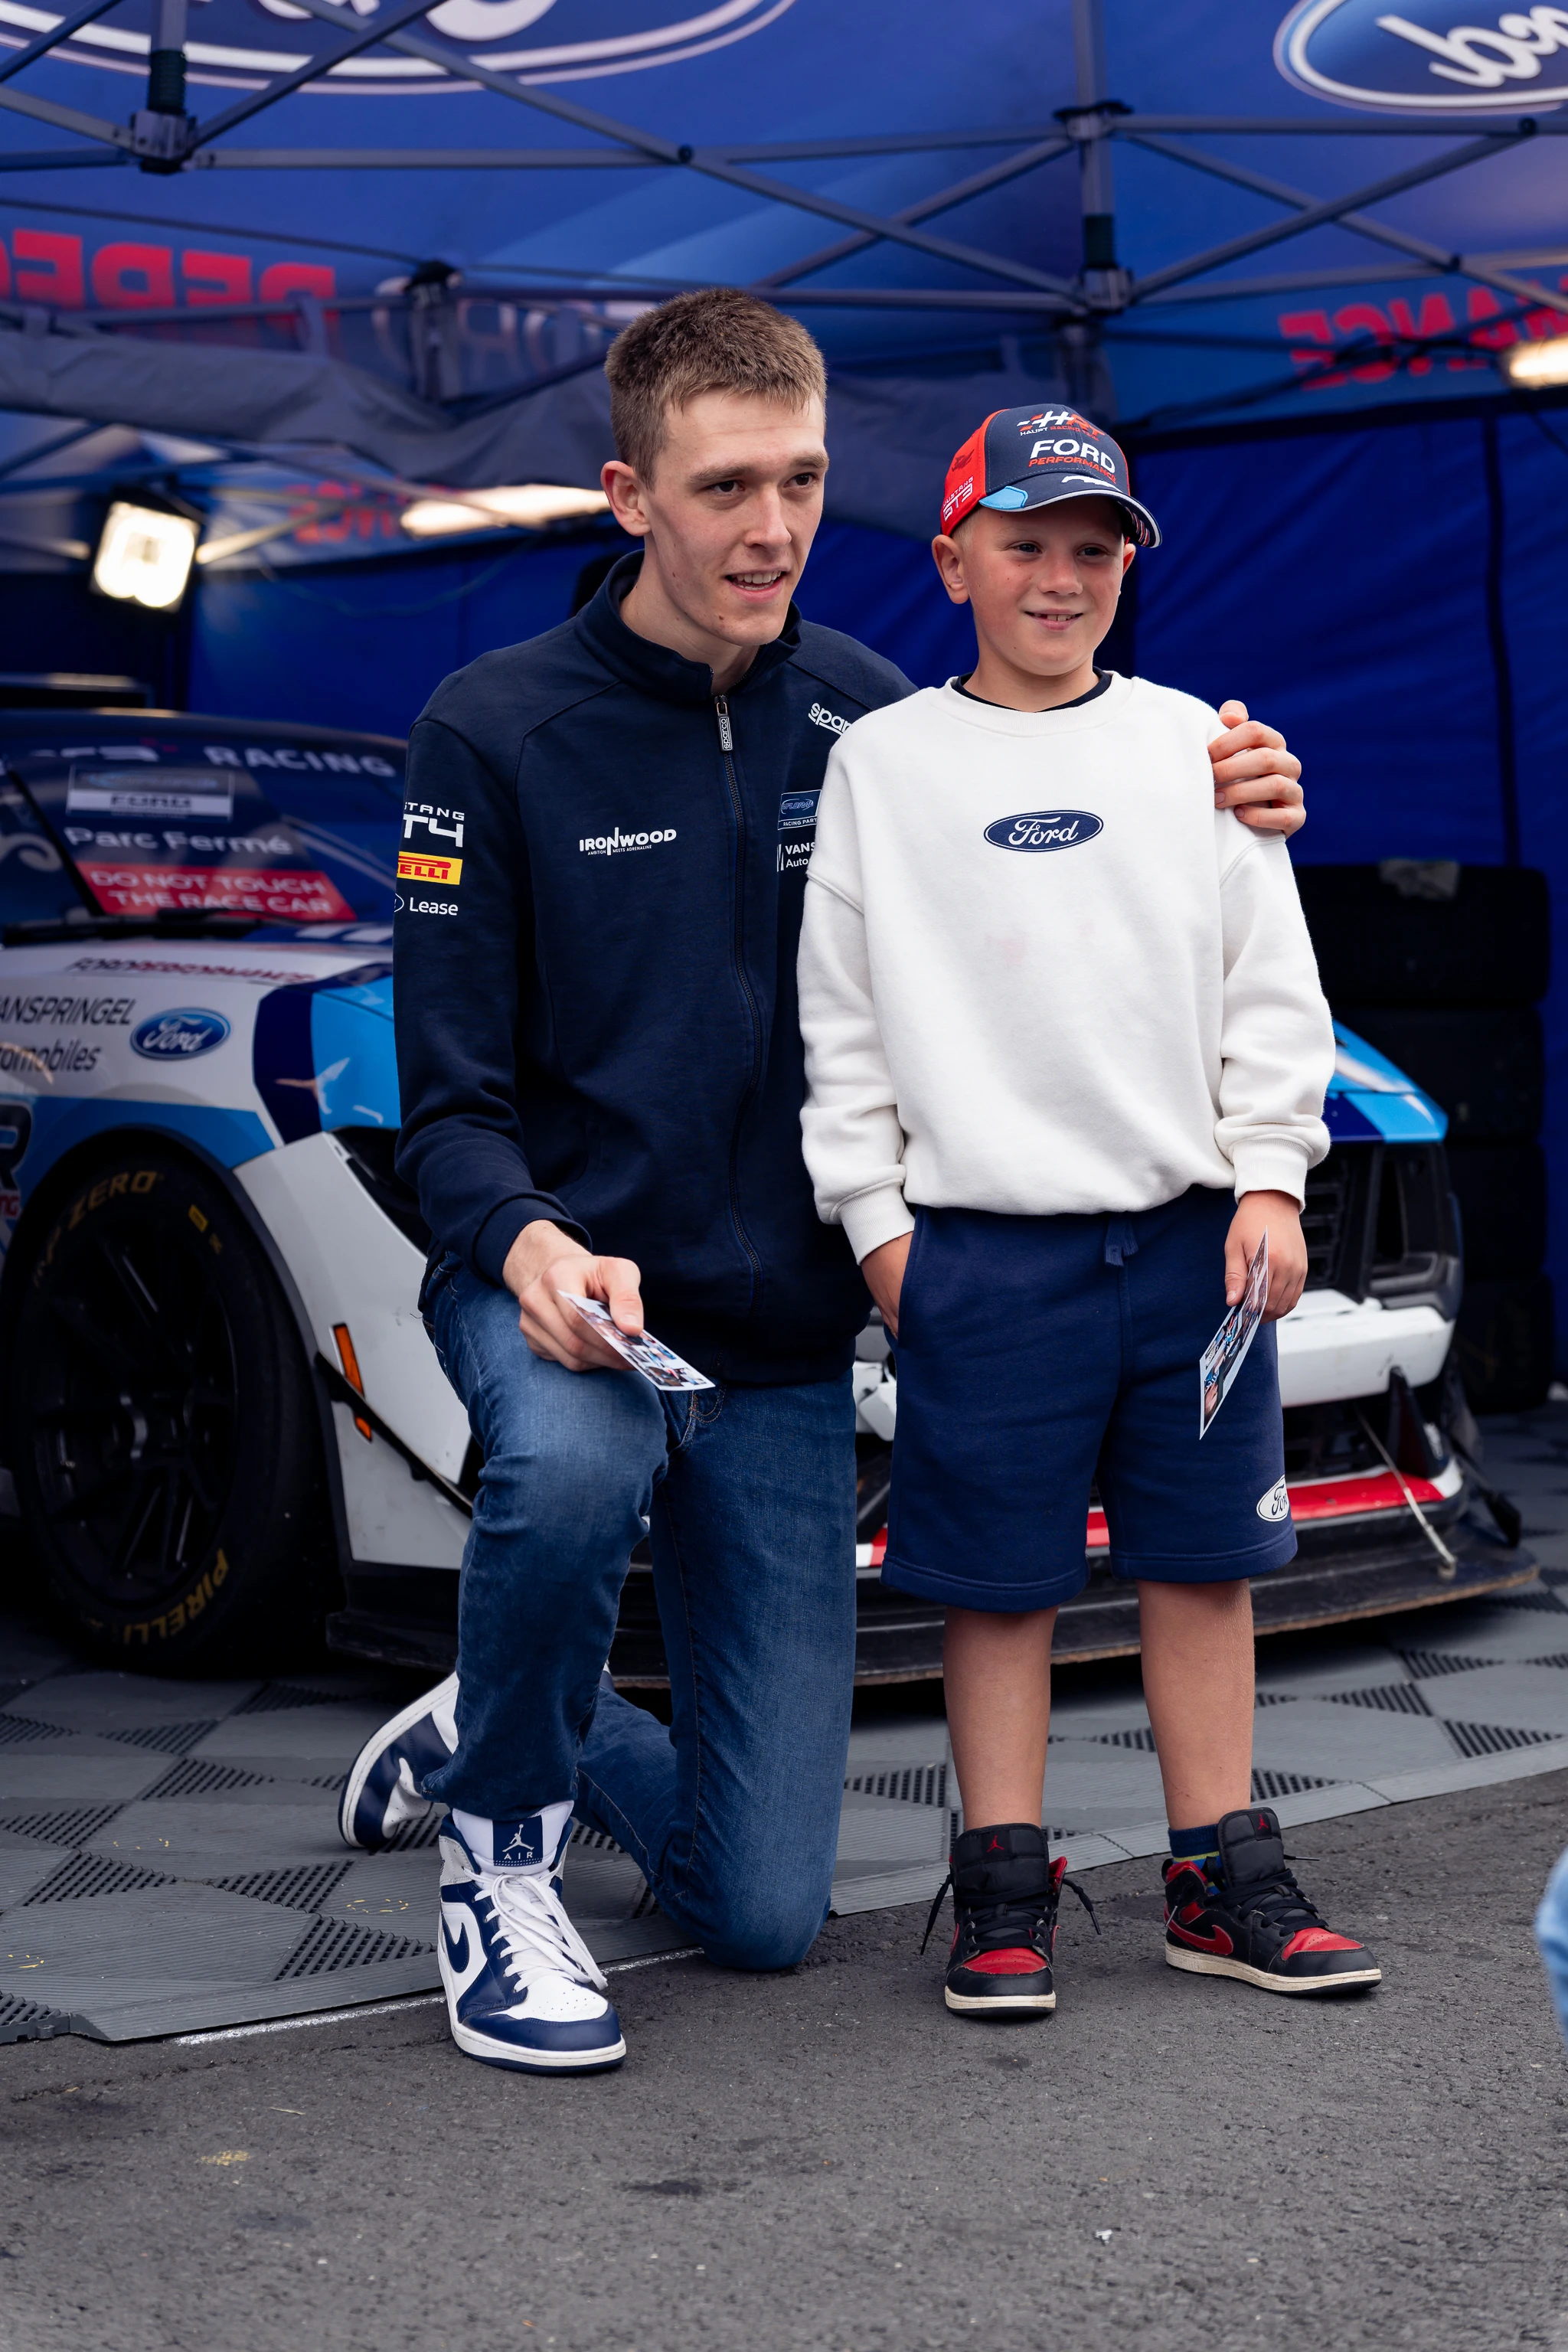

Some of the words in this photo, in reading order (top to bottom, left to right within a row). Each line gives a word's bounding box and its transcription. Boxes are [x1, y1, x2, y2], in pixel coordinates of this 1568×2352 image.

[1020, 427, 1048, 436] HAUPT
[1028, 456, 1116, 484] PERFORMANCE
[1030, 439, 1116, 473] FORD
[943, 475, 974, 508] MUSTANG
[943, 482, 973, 522] GT3
[720, 718, 731, 750] sparco
[203, 746, 397, 778] RACING
[404, 802, 465, 821] TANG
[64, 827, 158, 850] Parc
[163, 830, 294, 856] Fermé
[403, 814, 464, 848] T4
[580, 827, 677, 856] IRONWOOD
[1008, 816, 1080, 845] Ford
[90, 871, 139, 887] DO
[142, 873, 207, 890] NOT
[213, 875, 327, 895] TOUCH
[397, 864, 449, 880] ELLI
[108, 890, 176, 909] THE
[178, 893, 264, 912] RACE
[267, 897, 332, 915] CAR
[410, 897, 459, 916] Lease
[142, 1015, 213, 1052] Ford
[67, 1169, 158, 1232] ZERO
[1272, 1484, 1288, 1515] For
[122, 1547, 230, 1647] PIRELLI
[504, 1851, 533, 1860] AIR
